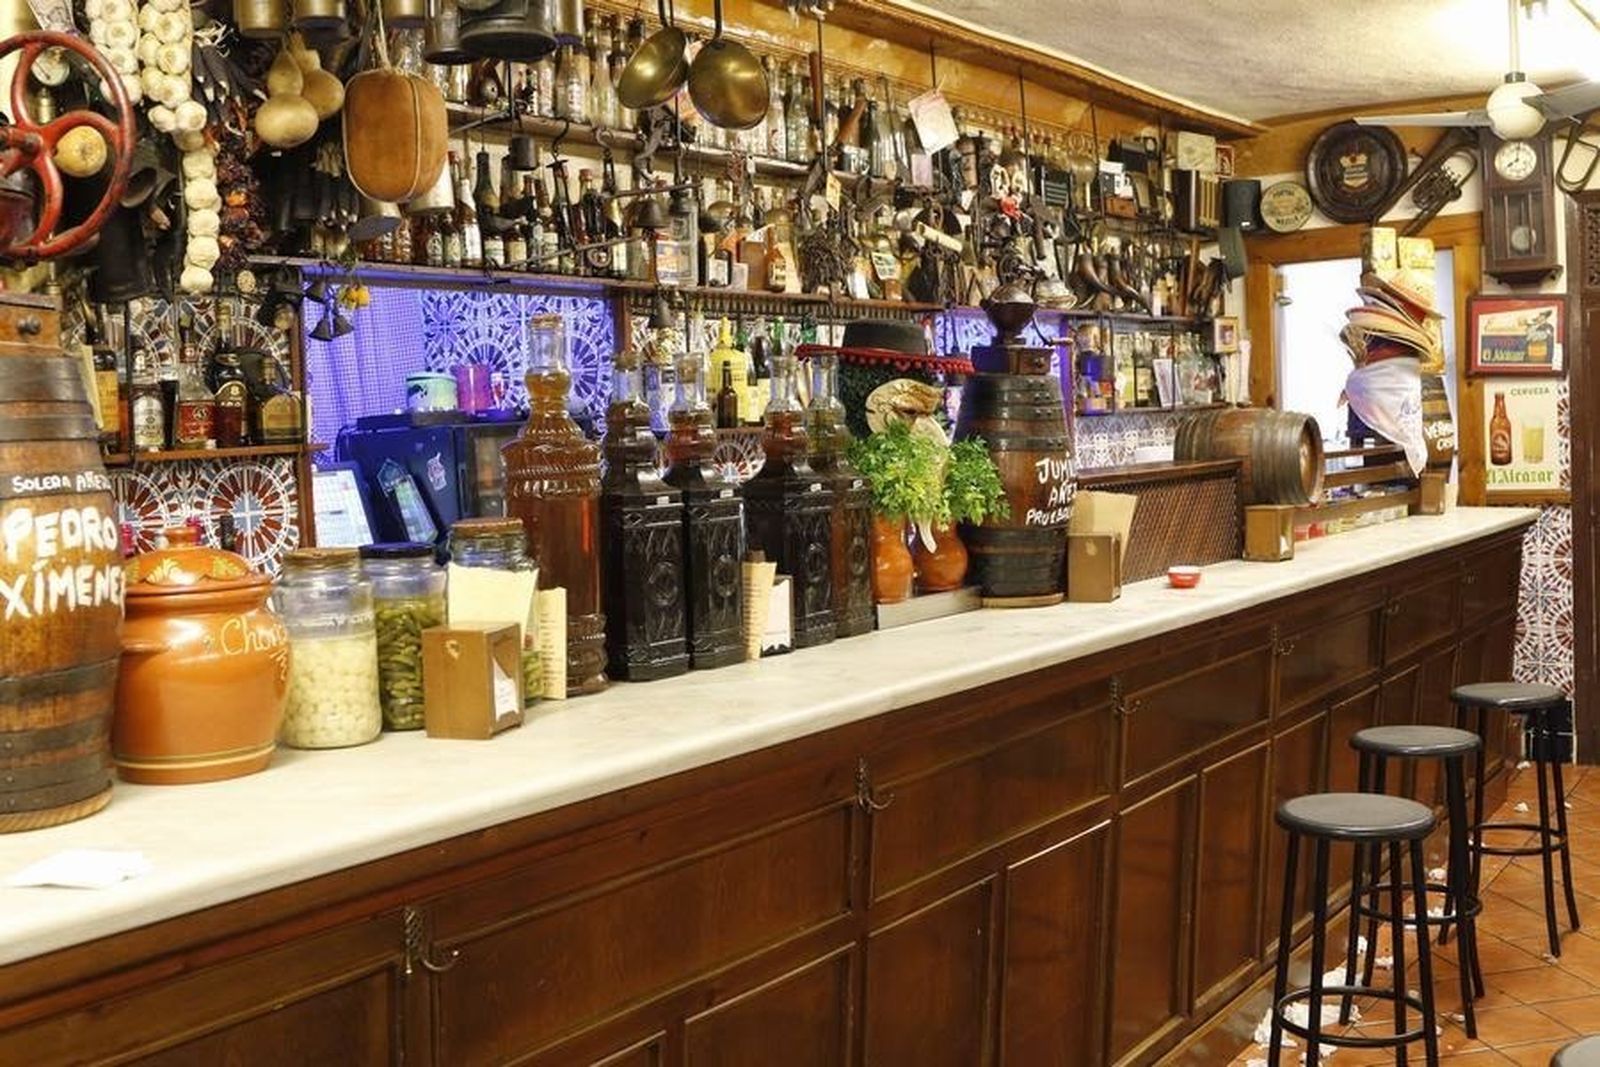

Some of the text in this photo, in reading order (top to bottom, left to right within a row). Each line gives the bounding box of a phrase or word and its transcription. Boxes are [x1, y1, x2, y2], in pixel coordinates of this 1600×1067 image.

[12, 475, 72, 493] SOLERA
[3, 506, 118, 565] PEDRO
[0, 559, 126, 621] XÍMENE
